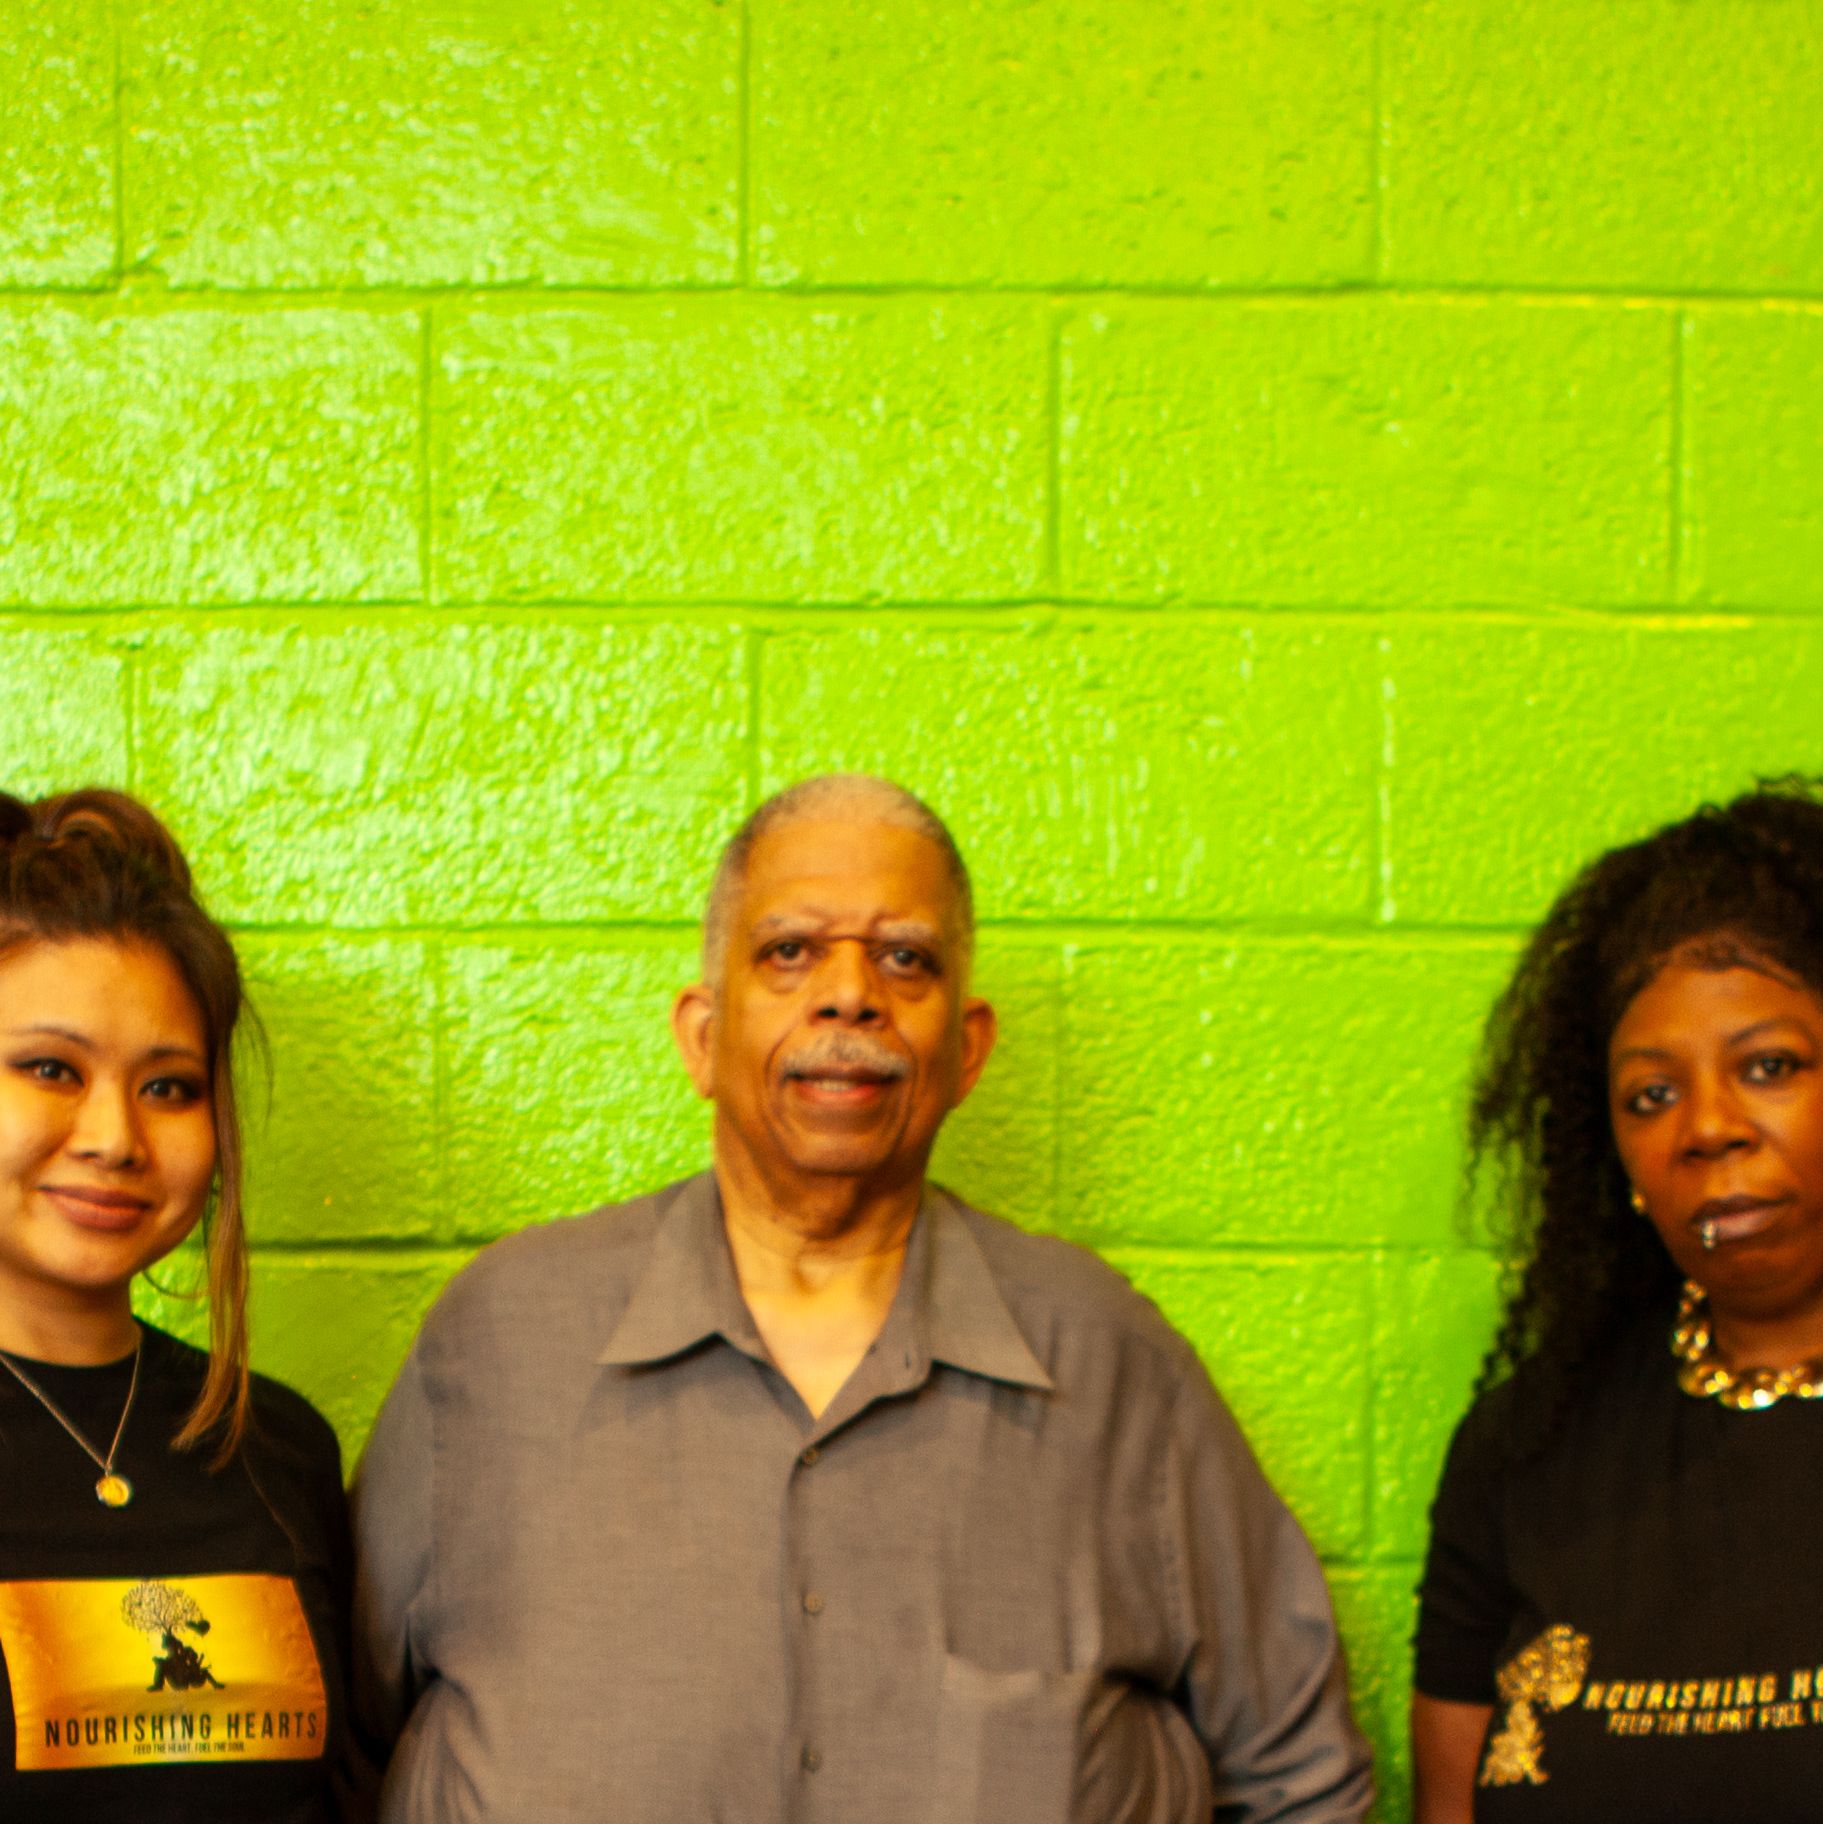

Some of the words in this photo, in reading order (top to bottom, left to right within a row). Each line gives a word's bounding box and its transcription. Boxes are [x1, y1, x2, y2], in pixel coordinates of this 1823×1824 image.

[1583, 1675, 1777, 1711] NOURISHING
[45, 1713, 212, 1747] NOURISHING
[226, 1711, 318, 1740] HEARTS
